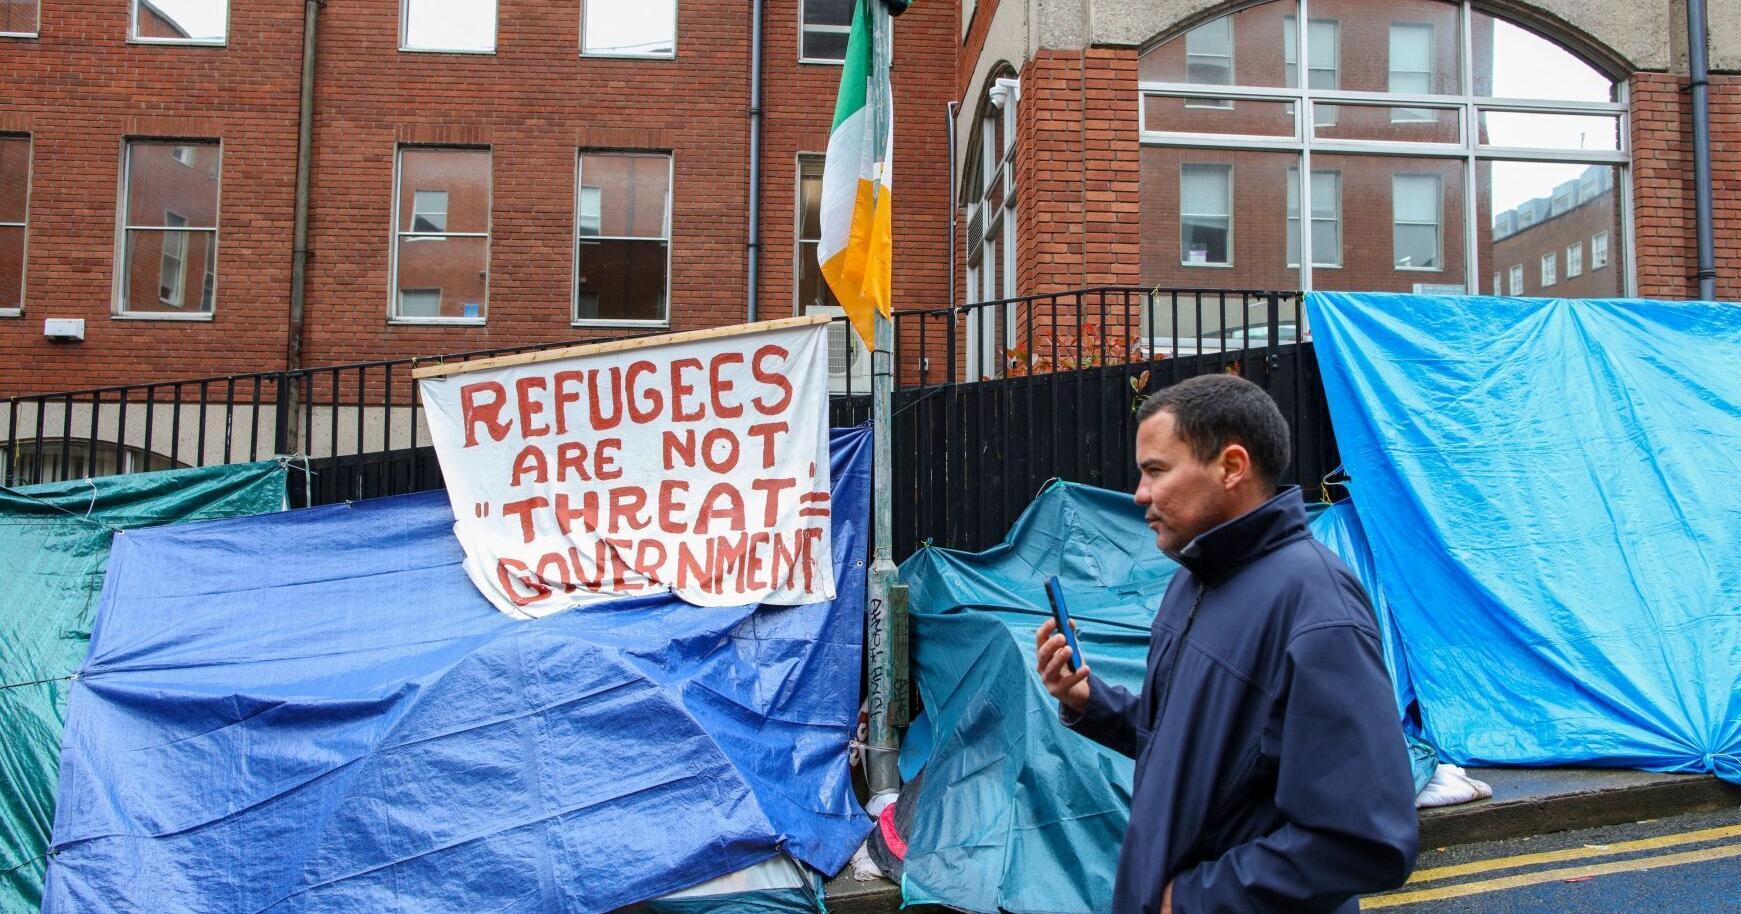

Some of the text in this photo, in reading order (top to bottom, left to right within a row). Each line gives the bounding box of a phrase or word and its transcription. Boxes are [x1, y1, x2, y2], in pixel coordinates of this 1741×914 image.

[460, 345, 793, 448] REFUGEES
[510, 421, 789, 487] ARE NOT
[496, 527, 824, 607] GOVERNMENT
